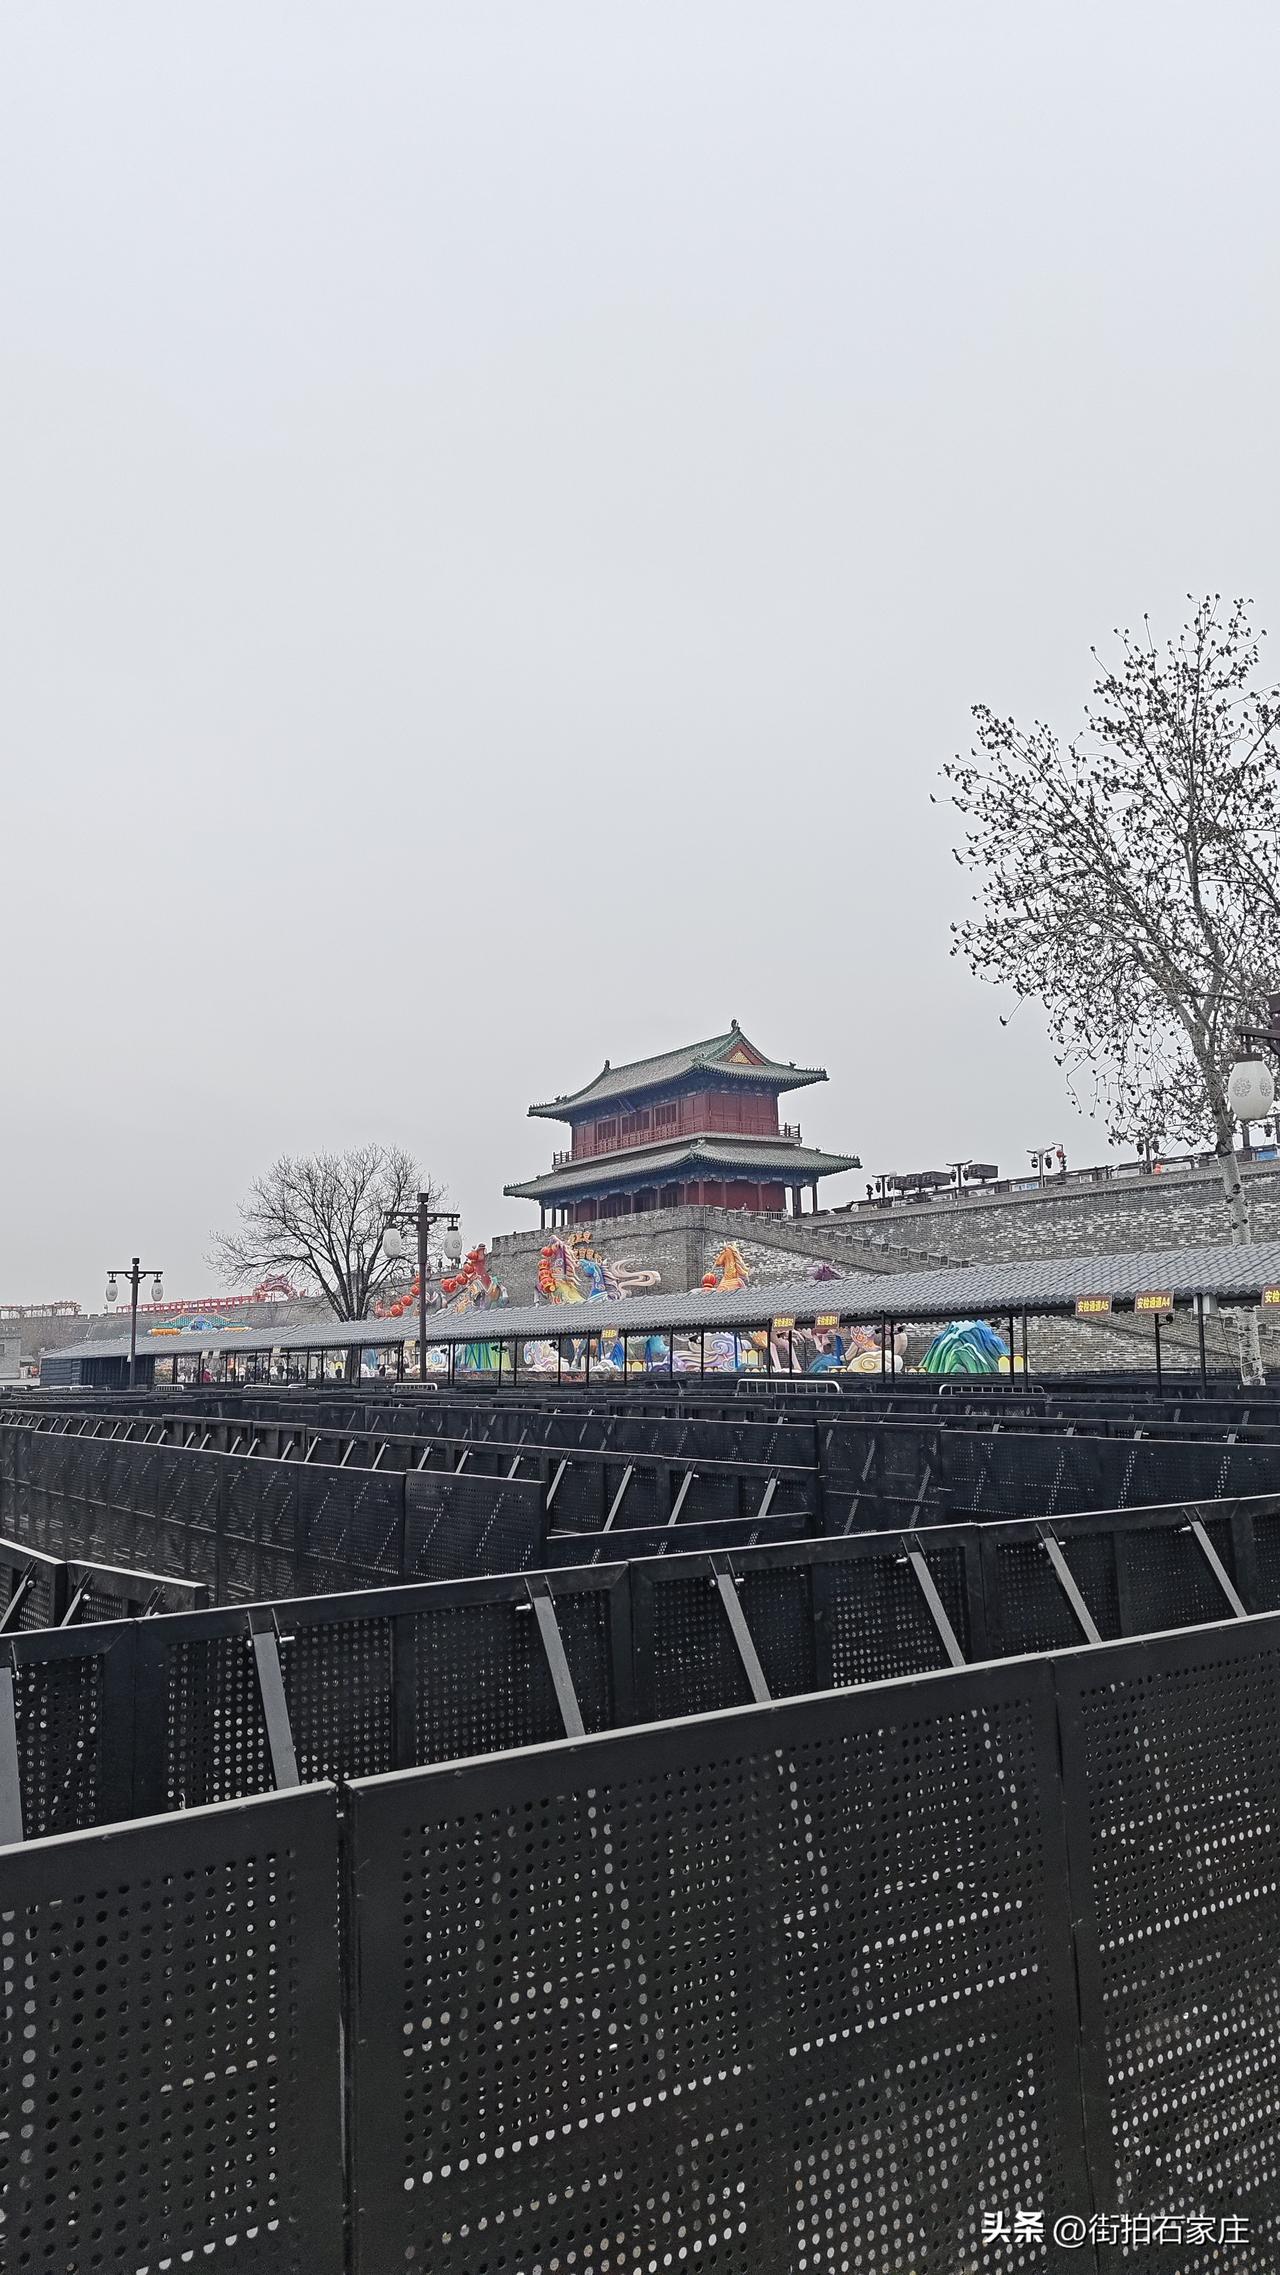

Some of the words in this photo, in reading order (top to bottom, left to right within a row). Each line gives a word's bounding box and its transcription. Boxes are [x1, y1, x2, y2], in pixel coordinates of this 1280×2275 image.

[1078, 1300, 1109, 1312] 安检通道A5
[1137, 1297, 1170, 1309] 安检通道A4
